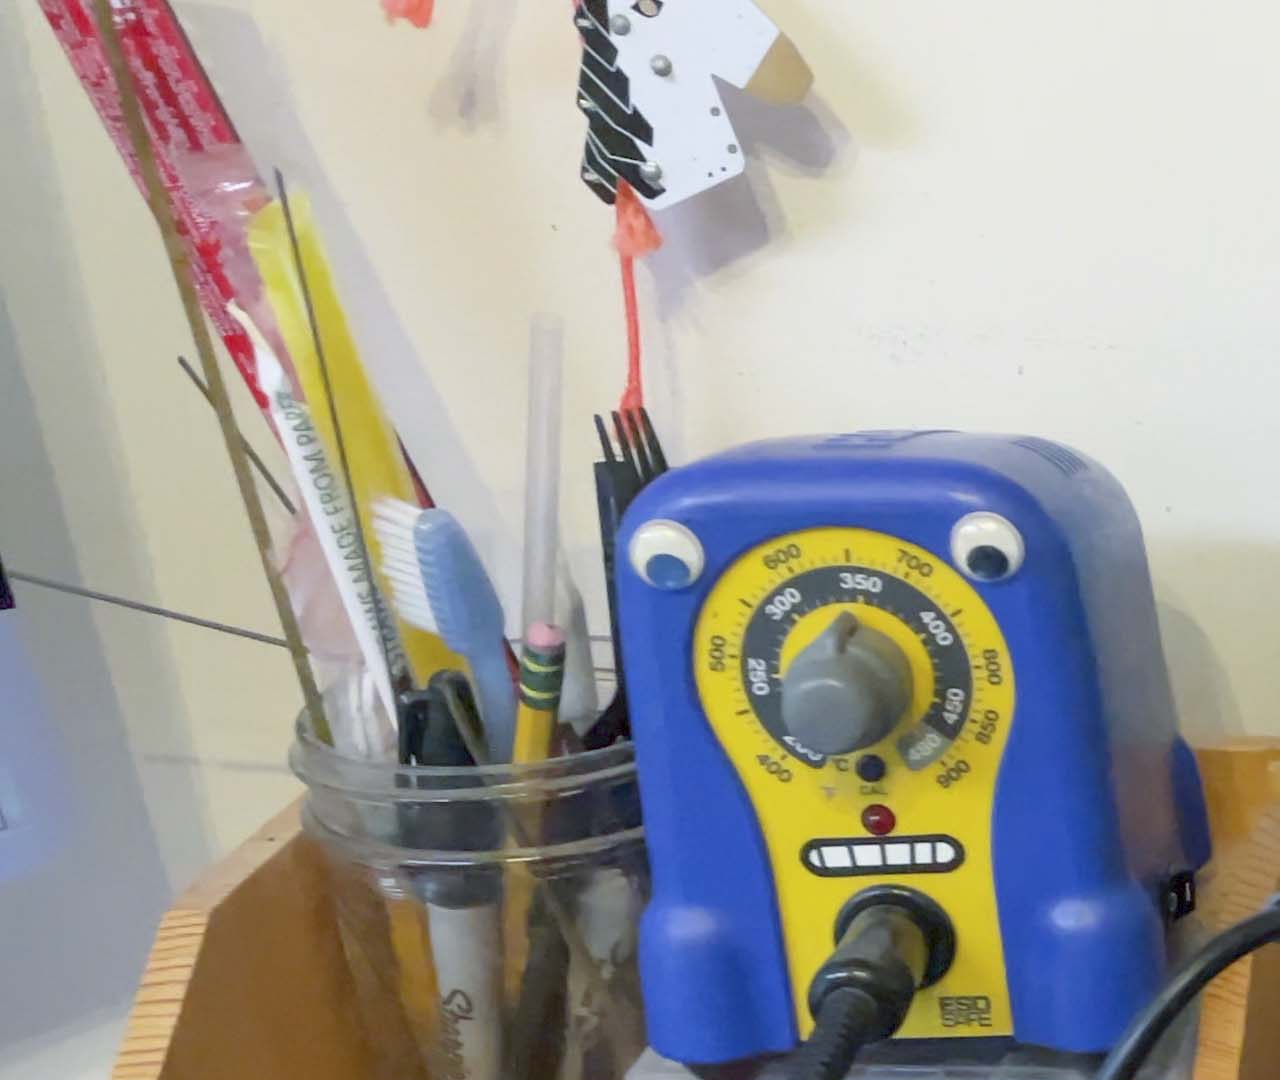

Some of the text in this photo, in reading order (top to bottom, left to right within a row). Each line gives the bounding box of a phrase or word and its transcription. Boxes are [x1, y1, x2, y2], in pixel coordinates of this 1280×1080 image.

[303, 450, 343, 517] FROM
[763, 543, 802, 571] 600
[897, 549, 935, 578] 700
[838, 572, 884, 594] 350
[764, 587, 802, 621] 300
[919, 610, 954, 647] 400
[708, 635, 728, 673] 500
[982, 648, 1002, 686] 800
[746, 657, 770, 696] 250
[942, 687, 966, 725] 450
[975, 709, 1000, 744] 850
[756, 753, 793, 783] 400
[935, 759, 971, 789] 900
